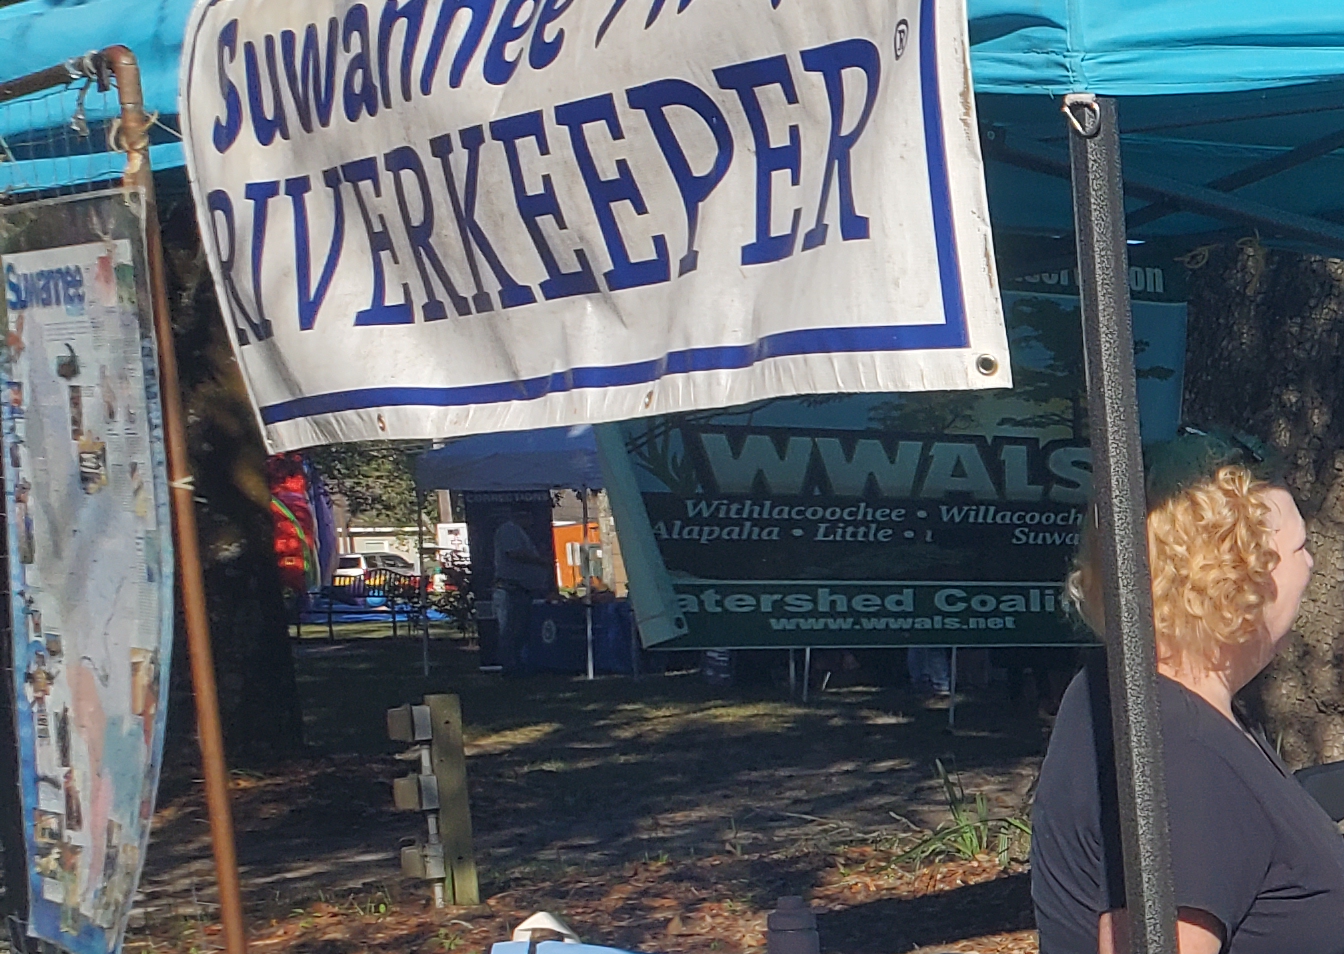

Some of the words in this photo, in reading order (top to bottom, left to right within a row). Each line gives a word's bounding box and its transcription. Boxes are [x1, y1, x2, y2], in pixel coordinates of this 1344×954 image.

[212, 0, 565, 155] Suwannee
[699, 431, 1095, 499] WWALS
[686, 498, 906, 523] Withlacoochee
[651, 521, 780, 545] Alapaha
[815, 520, 894, 544] Little
[770, 615, 1017, 630] www.wwals.net
